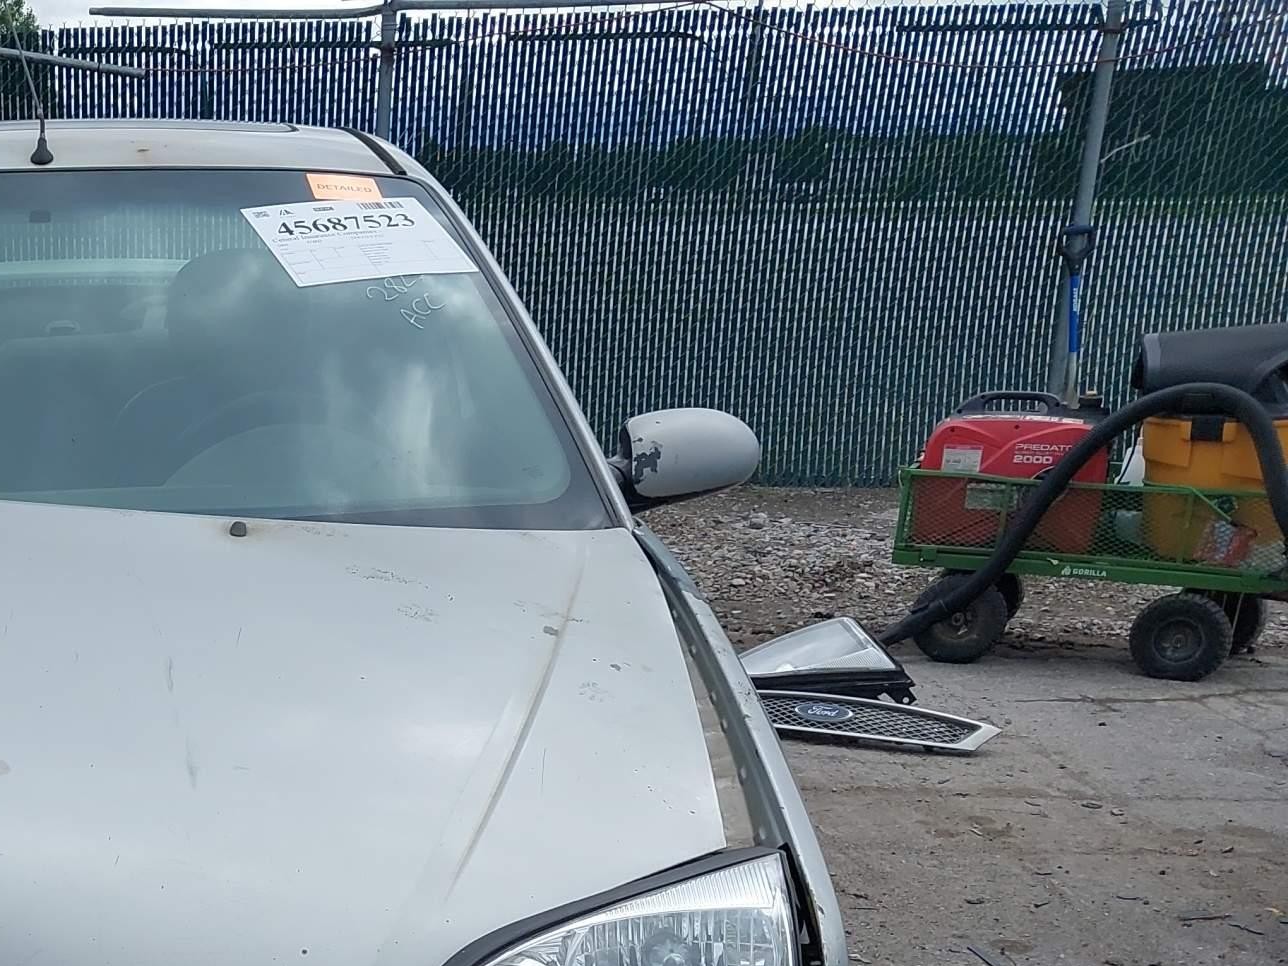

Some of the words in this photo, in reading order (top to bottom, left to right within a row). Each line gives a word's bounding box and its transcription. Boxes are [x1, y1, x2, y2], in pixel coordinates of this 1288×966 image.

[316, 183, 372, 193] DETAILED
[277, 213, 415, 236] 45687523
[1013, 454, 1053, 464] 2000
[1072, 568, 1107, 577] GORILLA
[807, 705, 840, 716] Ford
